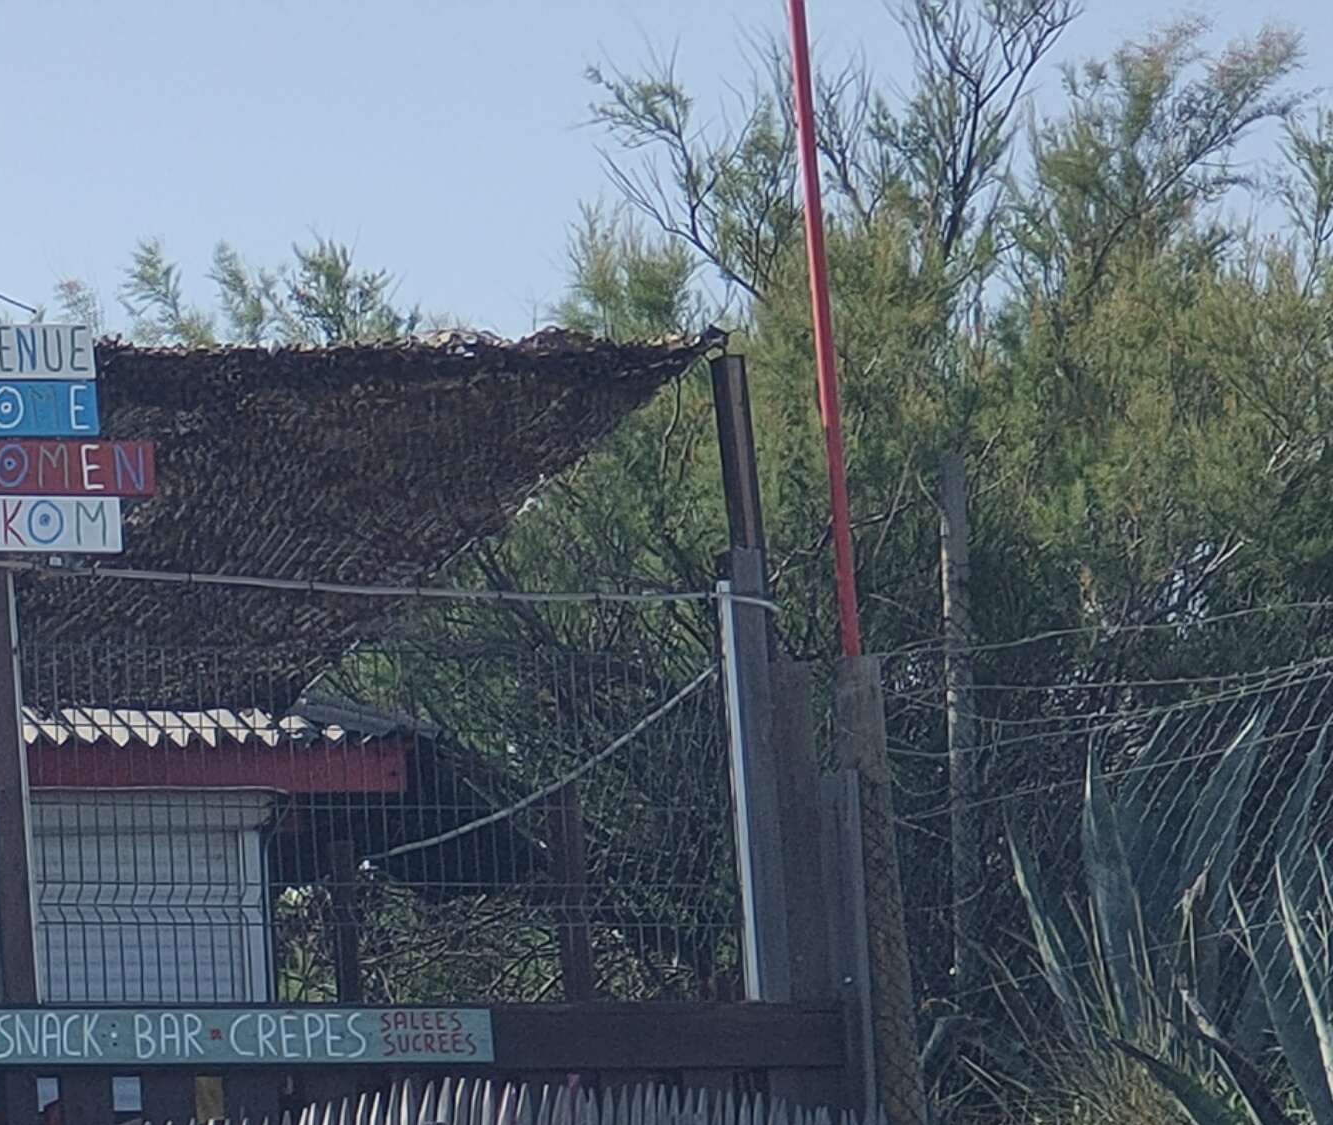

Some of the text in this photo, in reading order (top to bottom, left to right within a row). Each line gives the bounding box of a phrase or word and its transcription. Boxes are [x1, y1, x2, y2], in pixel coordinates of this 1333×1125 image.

[379, 1011, 462, 1033] SALEES
[135, 1012, 206, 1059] BAR
[383, 1033, 477, 1057] SUCREES
